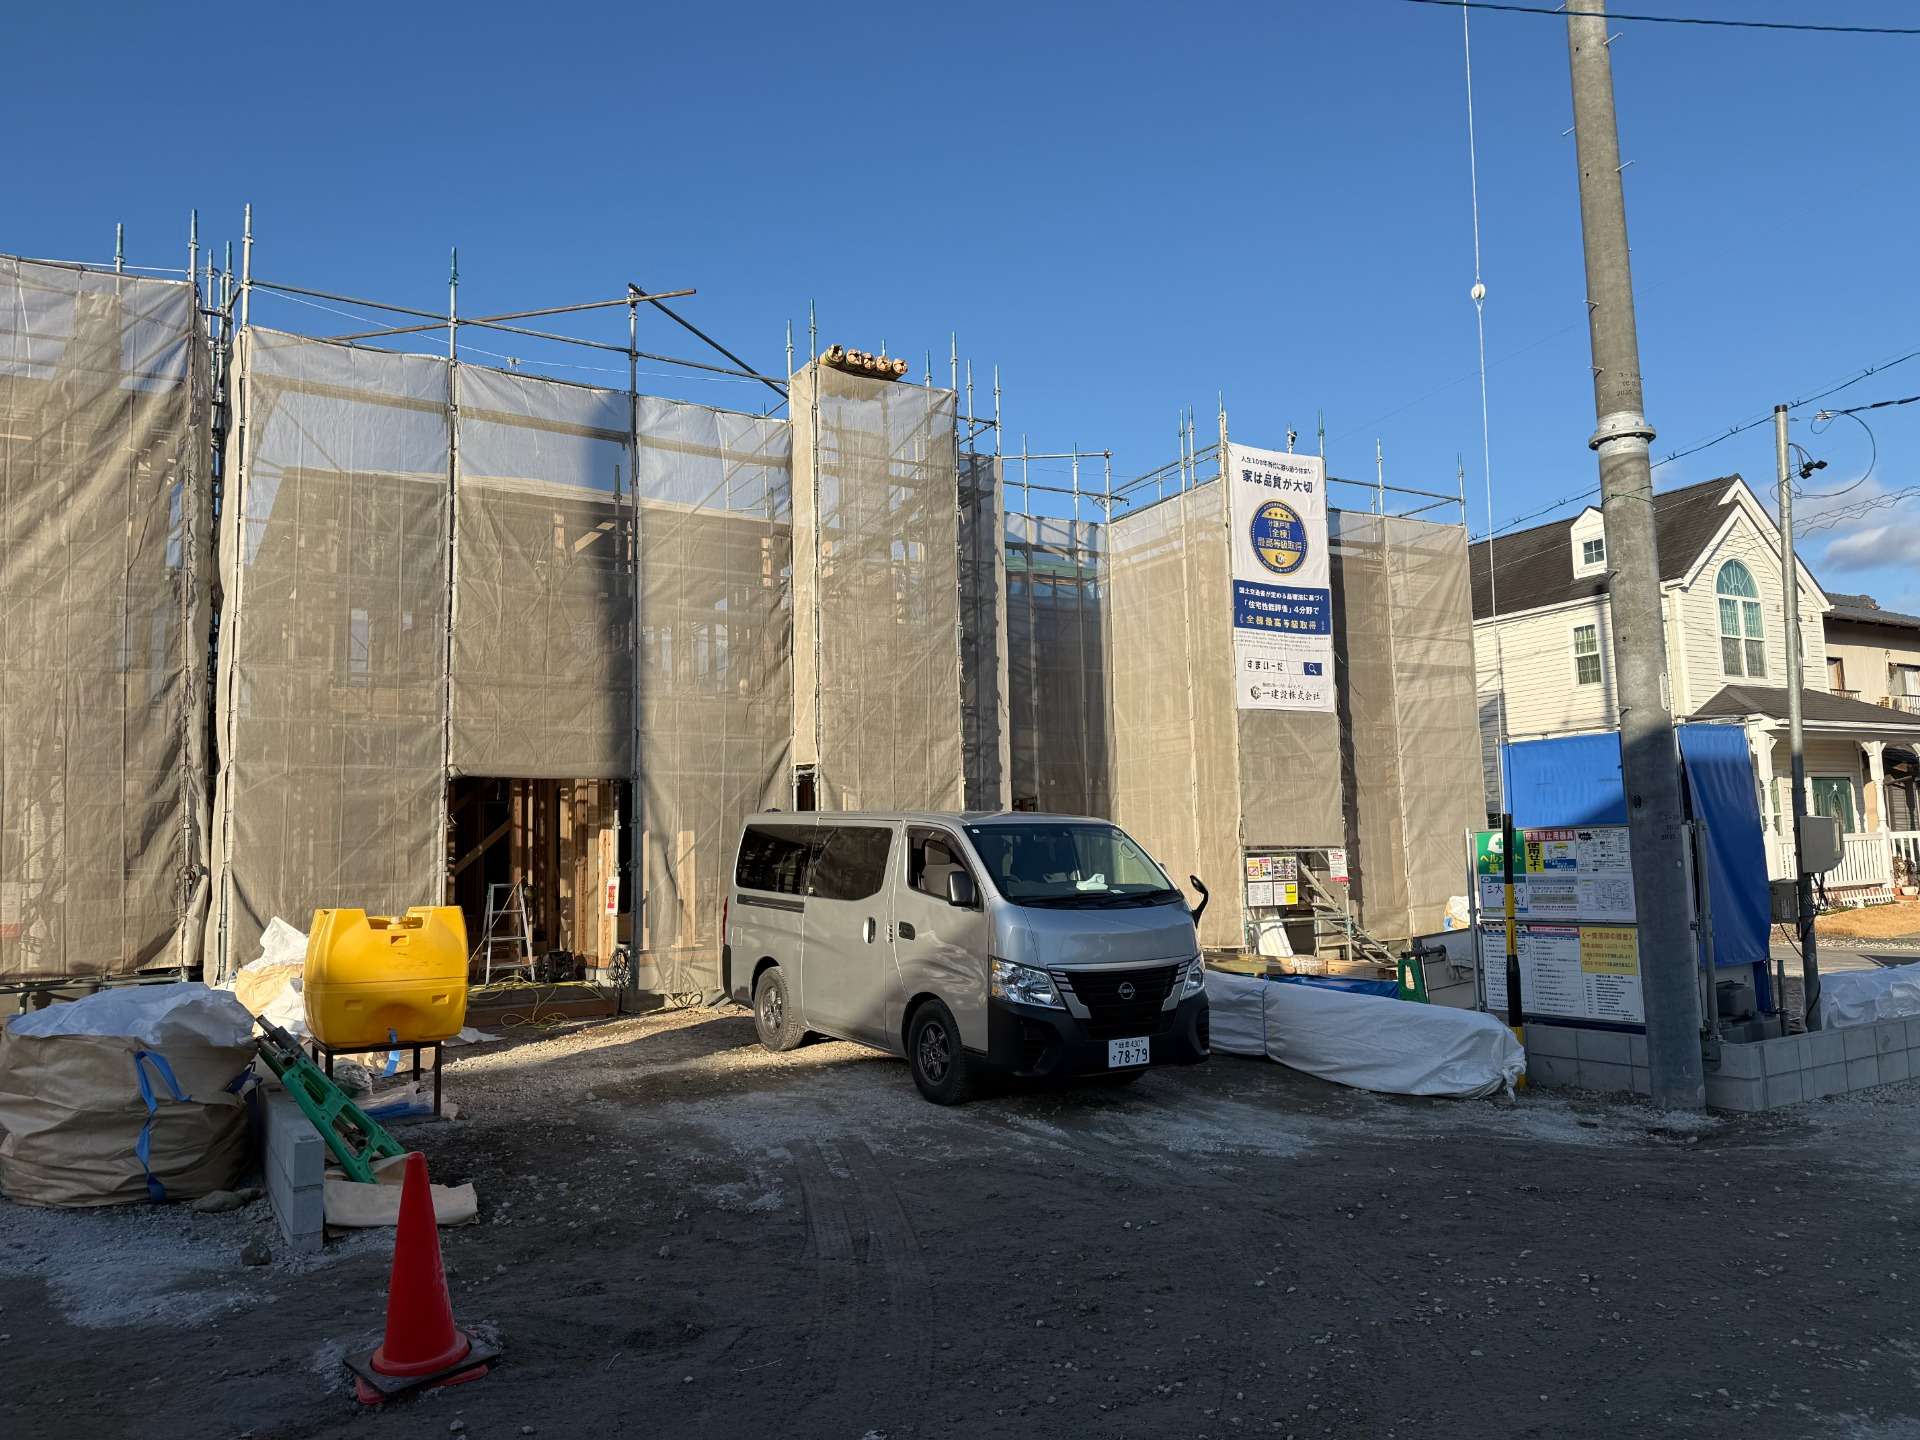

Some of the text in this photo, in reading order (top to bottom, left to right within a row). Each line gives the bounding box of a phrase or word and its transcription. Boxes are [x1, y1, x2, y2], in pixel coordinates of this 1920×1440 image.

[1242, 469, 1313, 493] 家は品質が大切
[1246, 614, 1317, 630] 全棟最高等級取得
[1262, 688, 1321, 701] 一建設株式会社
[1118, 1047, 1148, 1065] 78-79
